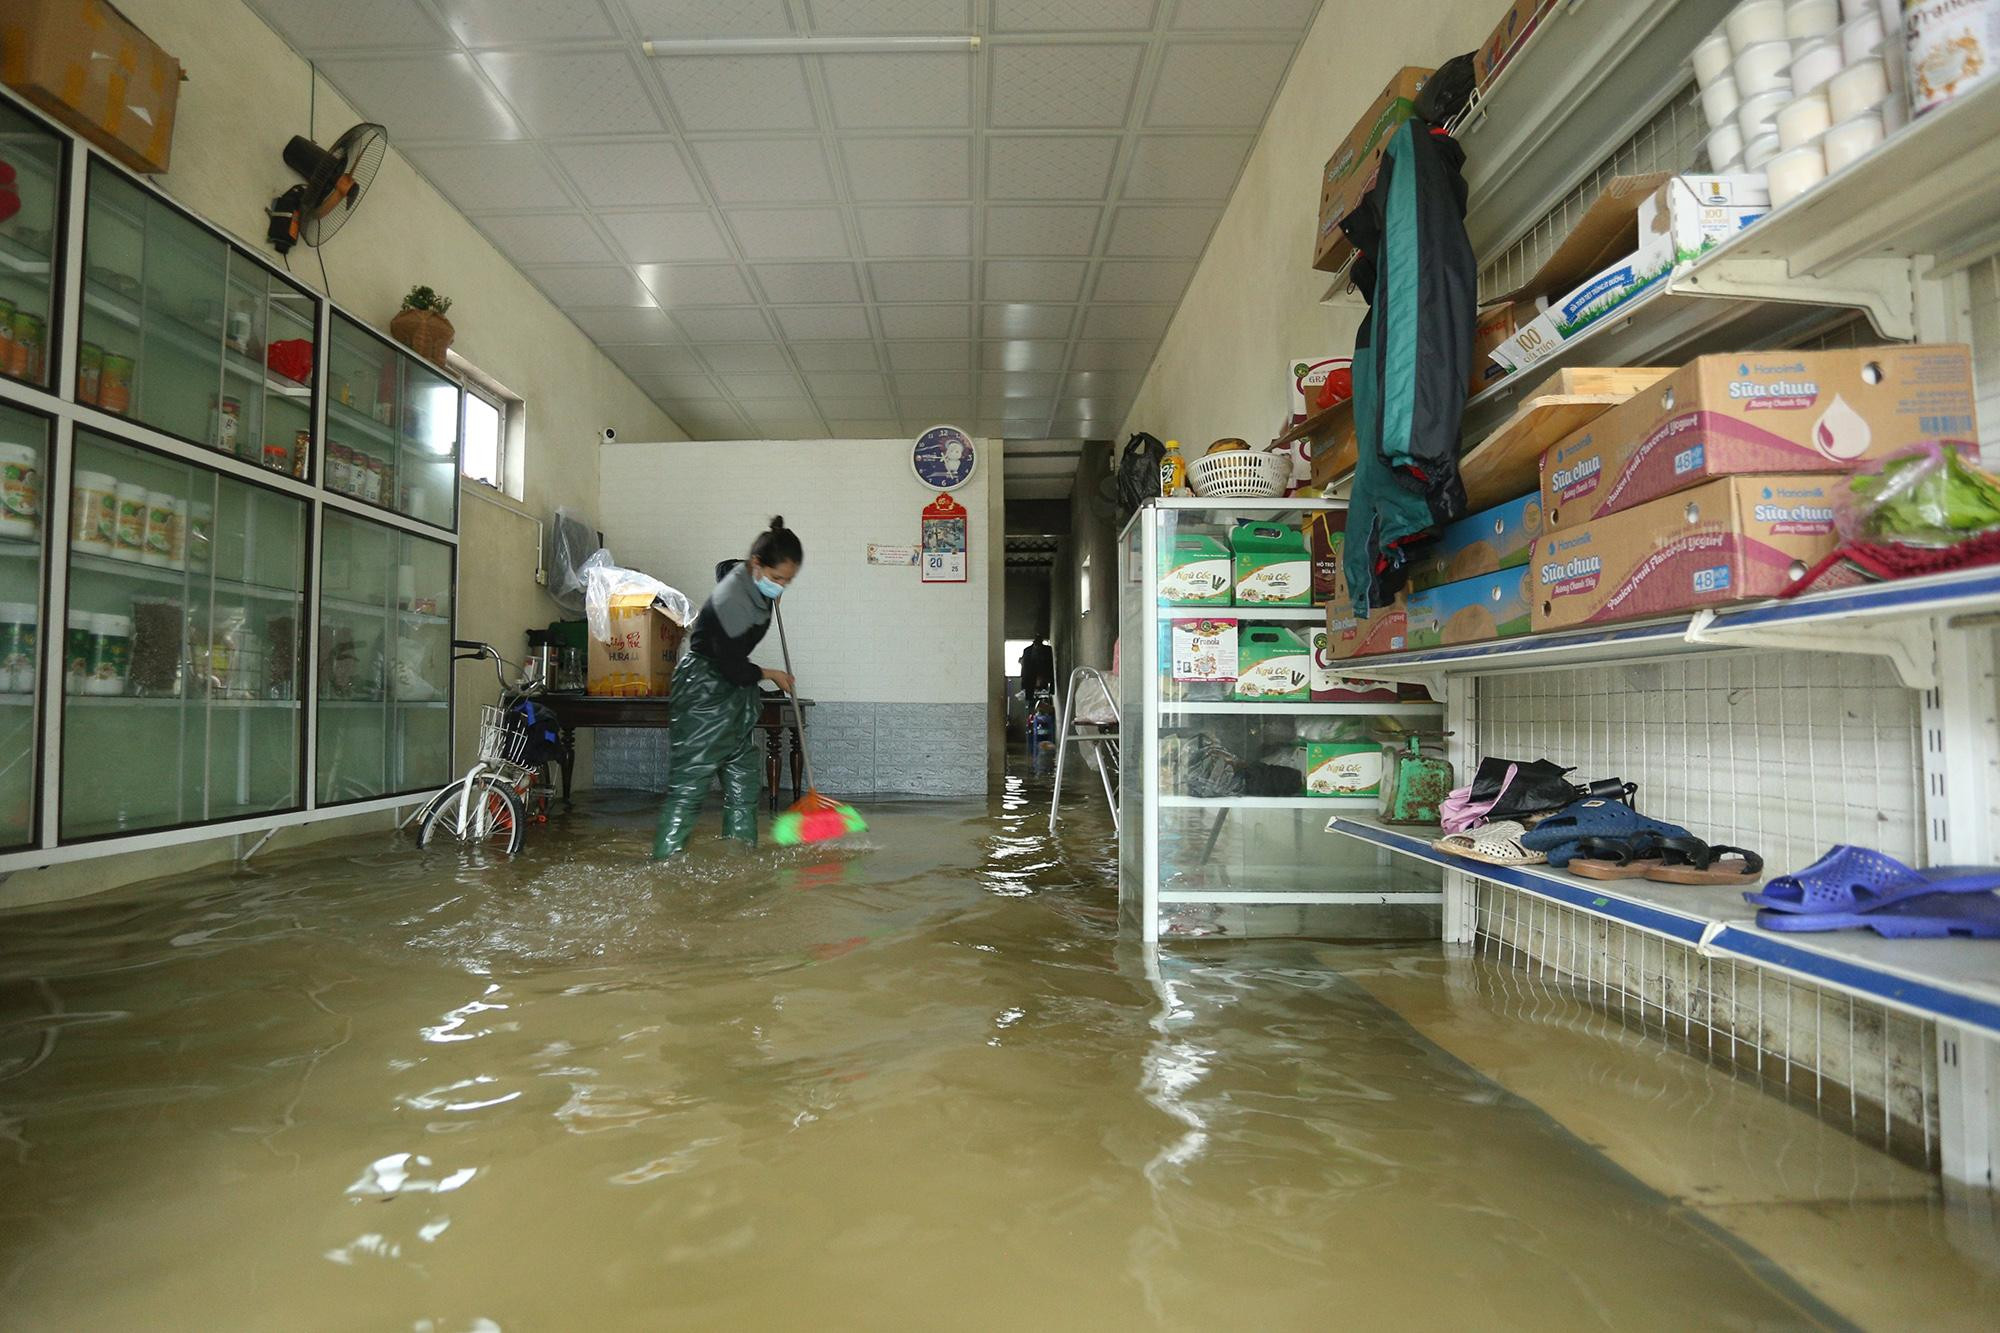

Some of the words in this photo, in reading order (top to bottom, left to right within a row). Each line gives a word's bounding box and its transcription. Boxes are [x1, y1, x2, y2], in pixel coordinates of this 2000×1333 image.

[1770, 381, 1817, 396] chua
[1573, 455, 1600, 481] chua
[1676, 452, 1690, 470] 48
[1792, 505, 1833, 520] chua
[930, 557, 942, 568] 20
[1567, 556, 1600, 577] chua
[1696, 572, 1712, 588] 48
